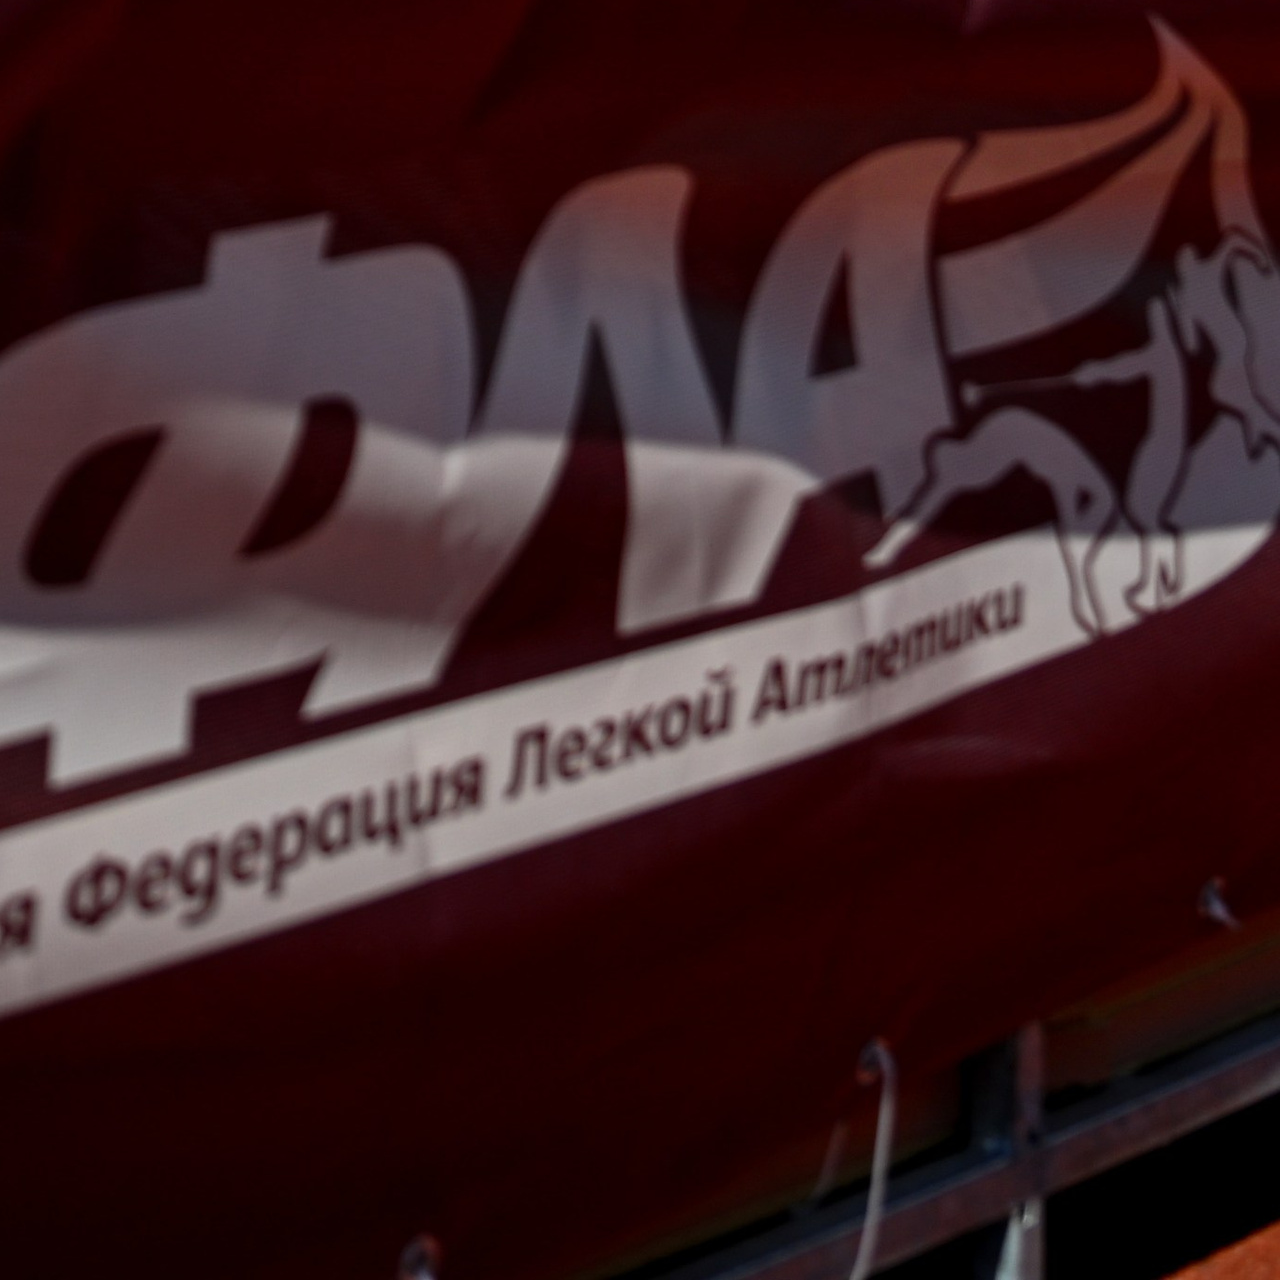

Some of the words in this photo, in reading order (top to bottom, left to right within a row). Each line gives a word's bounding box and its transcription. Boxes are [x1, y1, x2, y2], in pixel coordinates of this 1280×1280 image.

[62, 751, 488, 931] Федерация
[502, 664, 740, 802] Легкой
[749, 581, 1028, 726] Атлетики
